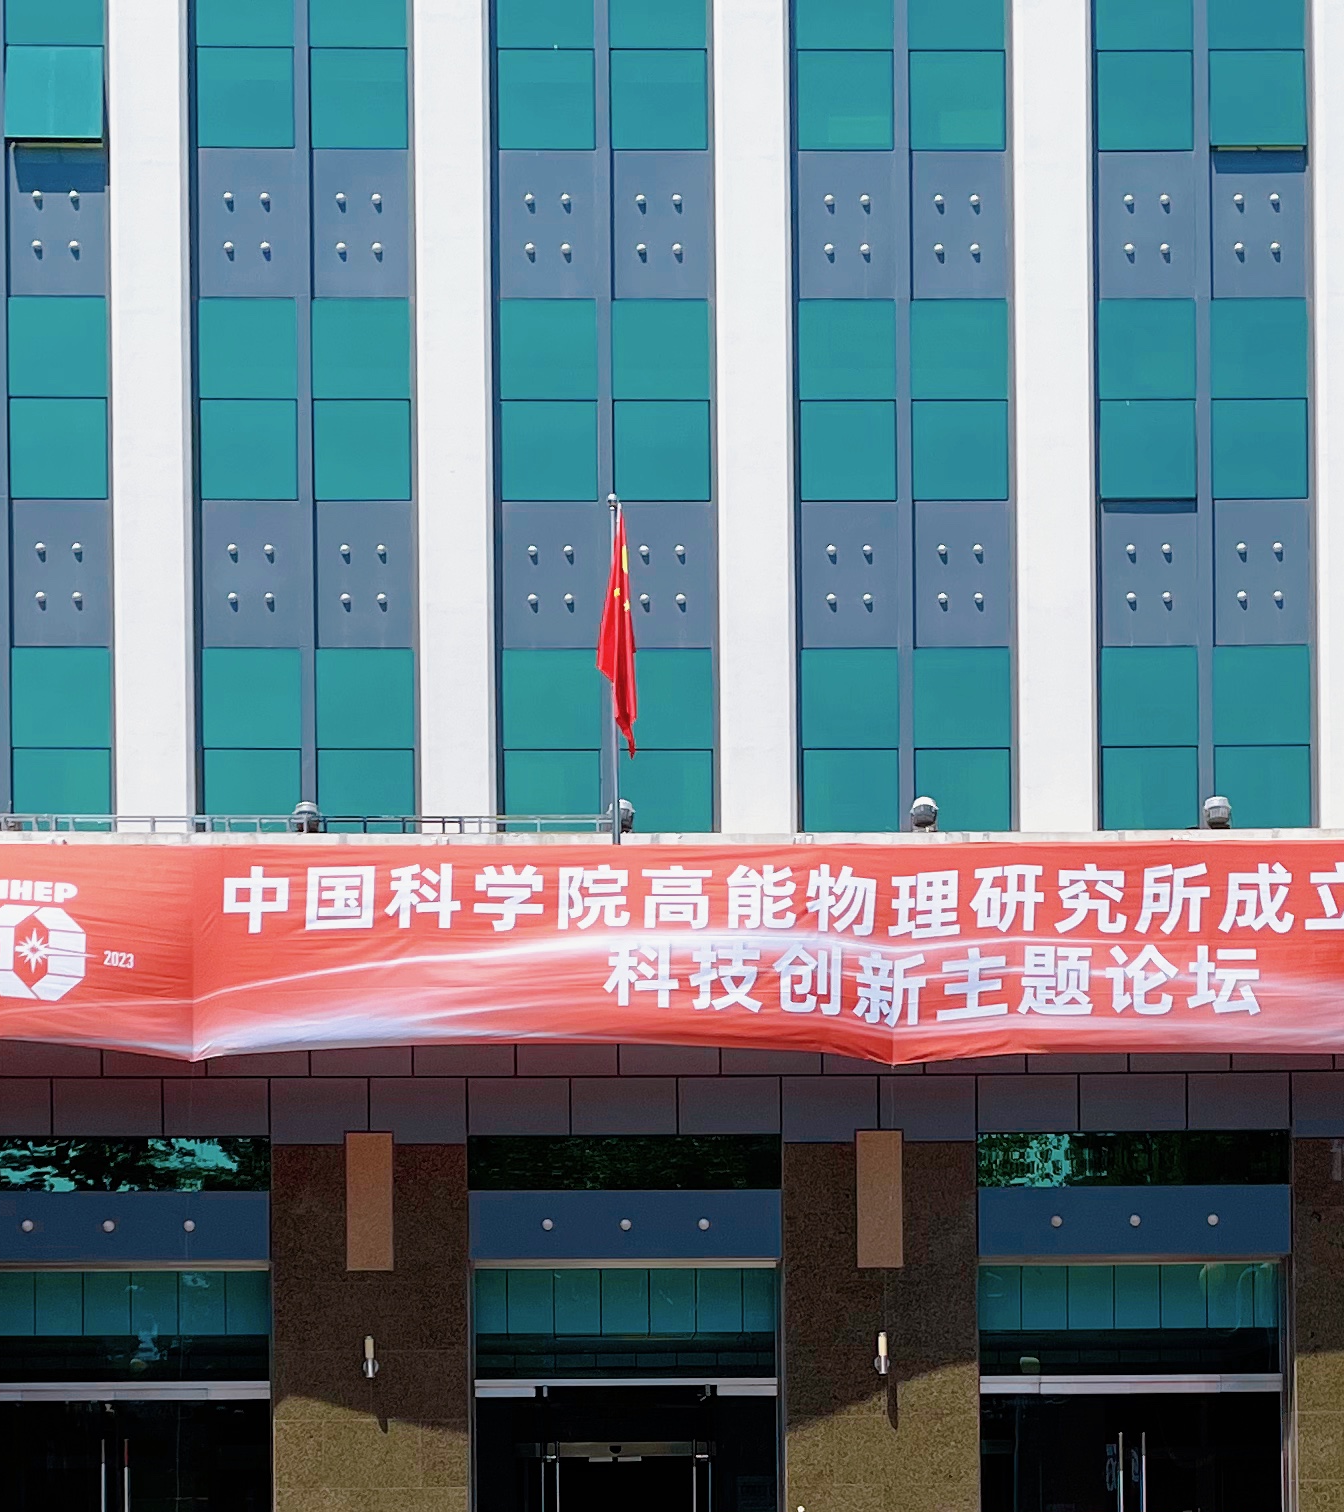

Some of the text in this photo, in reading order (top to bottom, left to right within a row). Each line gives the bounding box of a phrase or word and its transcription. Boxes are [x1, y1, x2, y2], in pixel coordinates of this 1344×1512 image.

[103, 951, 135, 968] 2023
[602, 943, 1260, 1027] 科技创新主题论坛
